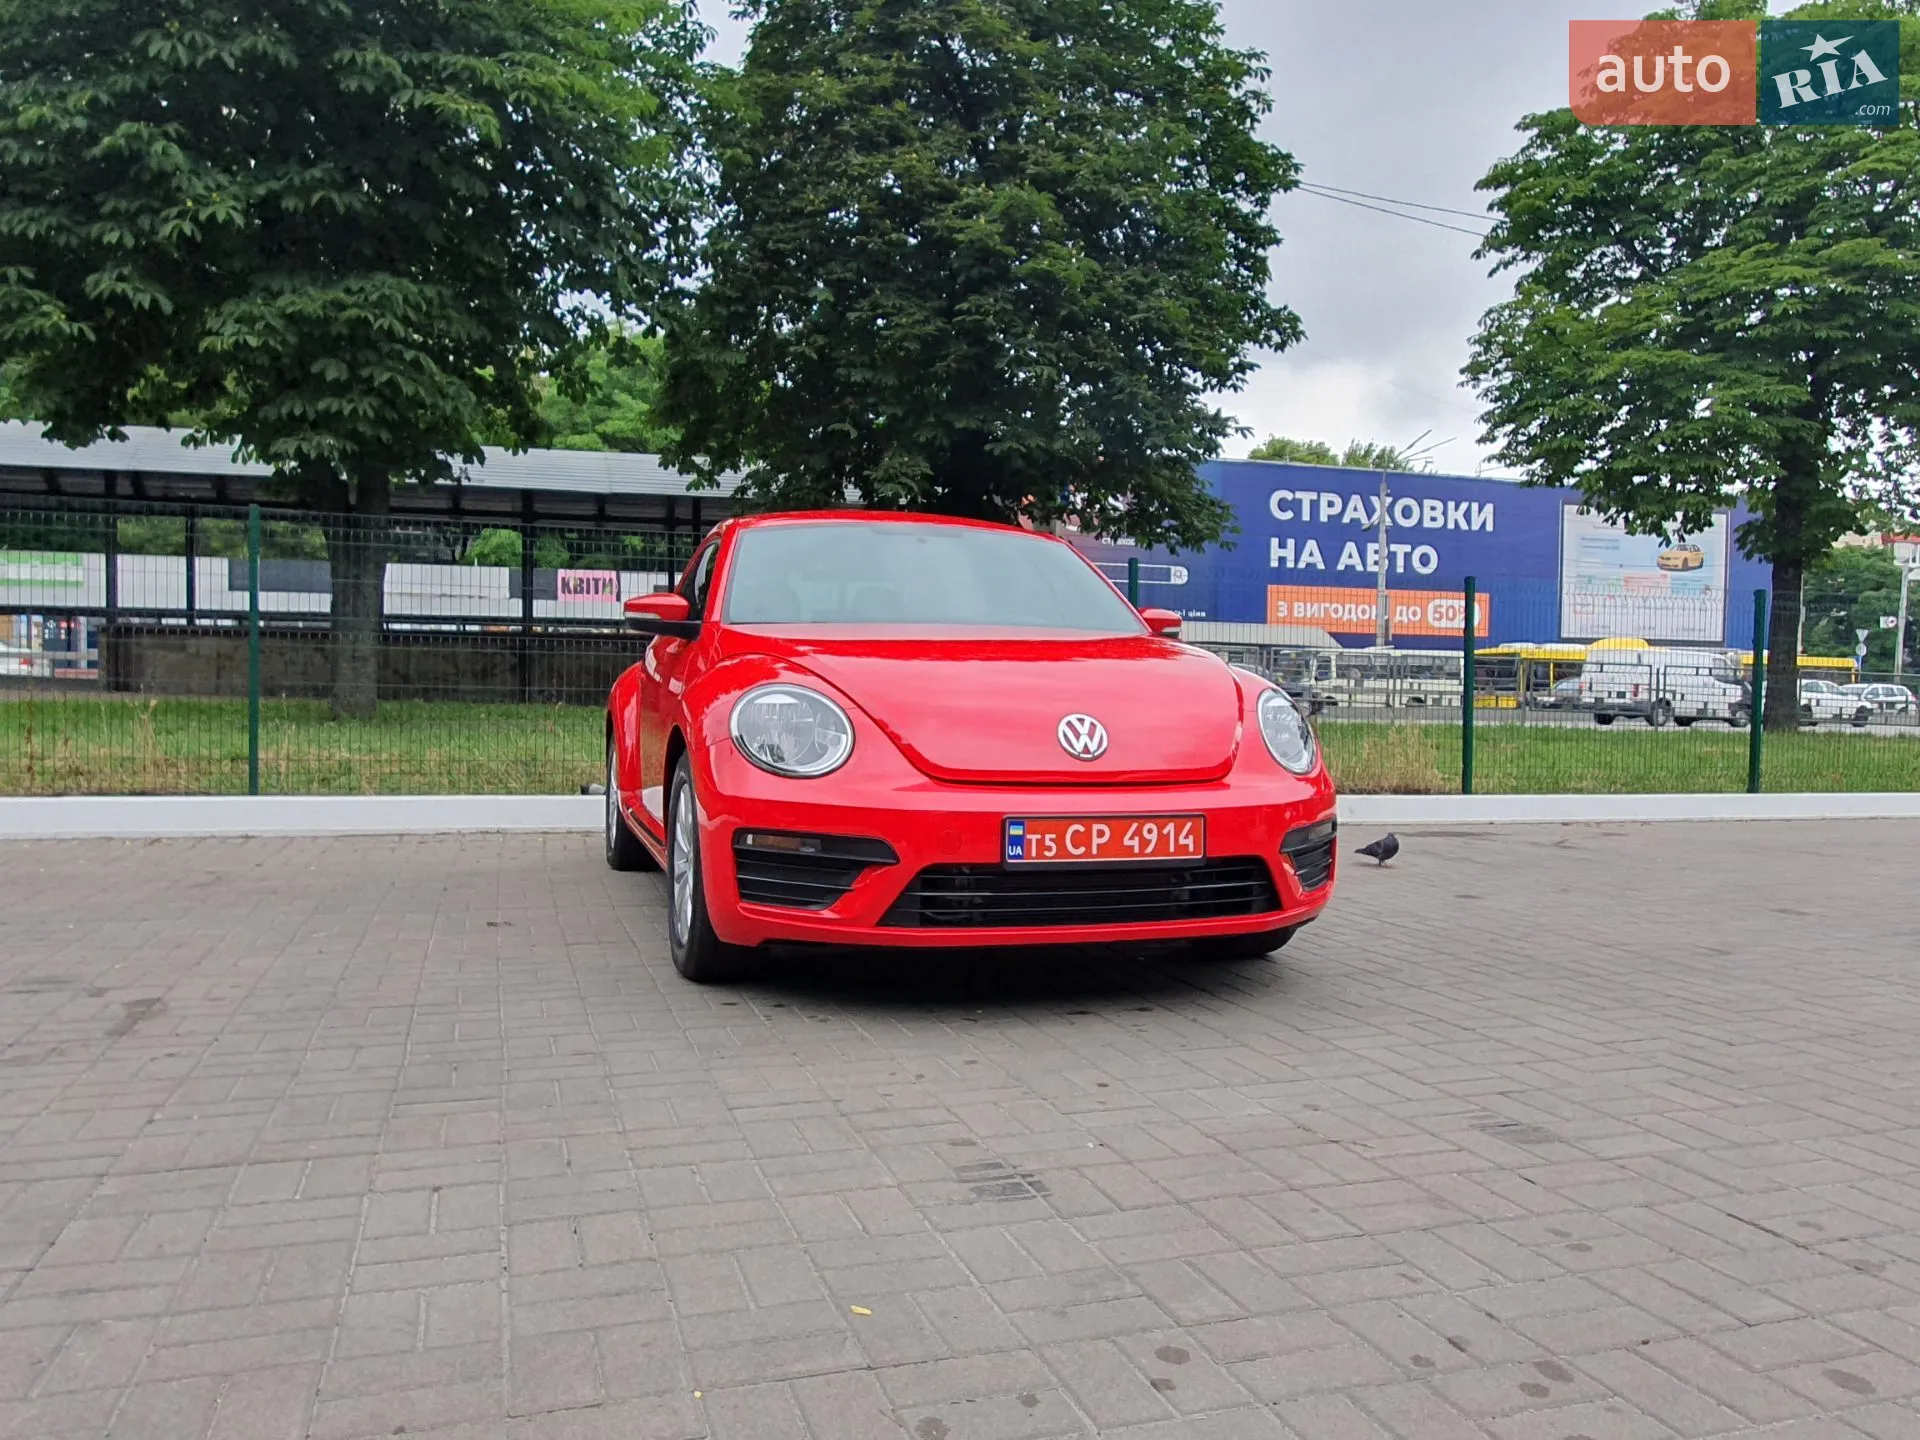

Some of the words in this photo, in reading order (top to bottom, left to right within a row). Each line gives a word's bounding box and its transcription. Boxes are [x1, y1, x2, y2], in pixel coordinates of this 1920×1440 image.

[1269, 489, 1494, 532] СТРАХОВКИ
[1270, 537, 1325, 570] НА
[1336, 541, 1439, 575] АВТО
[561, 577, 614, 595] КВІТИ
[1008, 845, 1023, 856] UA
[1026, 834, 1057, 857] T5
[1123, 822, 1194, 853] 4914
